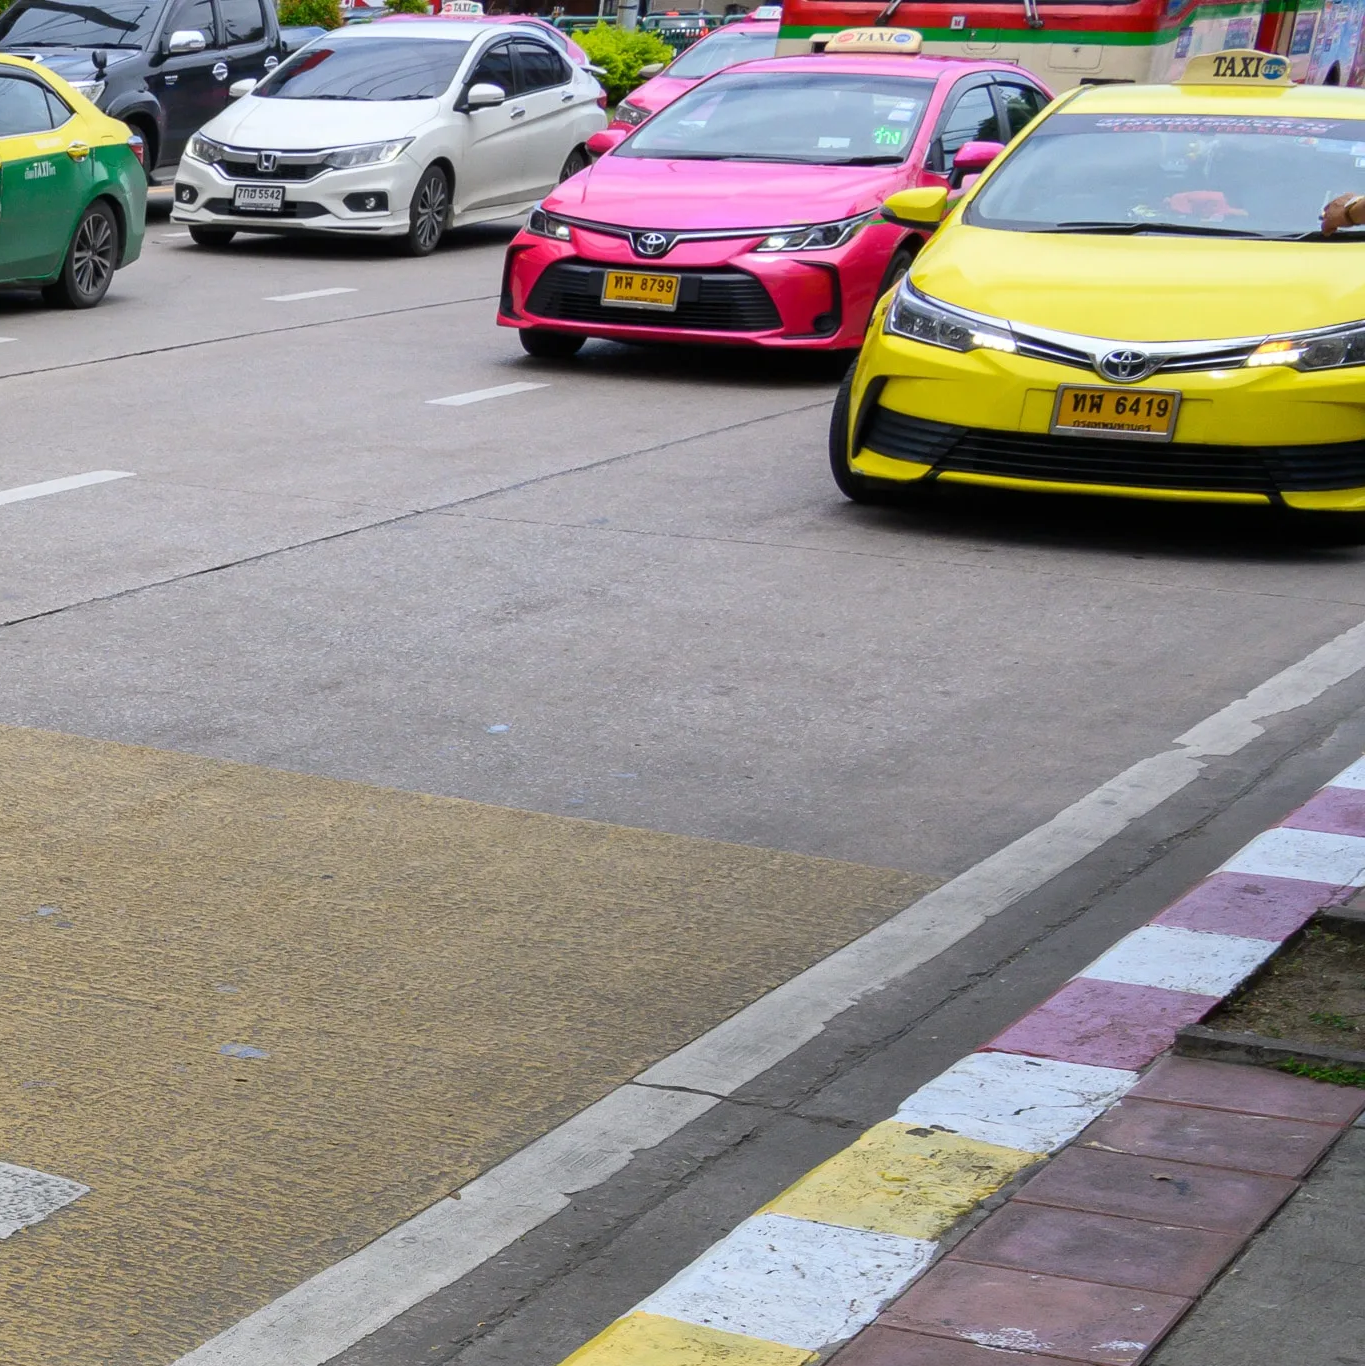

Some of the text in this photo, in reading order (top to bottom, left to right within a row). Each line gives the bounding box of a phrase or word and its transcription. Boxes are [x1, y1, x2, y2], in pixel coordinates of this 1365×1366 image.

[856, 32, 895, 42] TAXI
[1212, 56, 1287, 78] TAXI GPS
[874, 125, 901, 145] ว่าง
[258, 190, 281, 200] 5542
[640, 277, 674, 294] 8799
[1114, 396, 1169, 418] 6419
[1072, 419, 1152, 432] กรงเทพมหานคร
